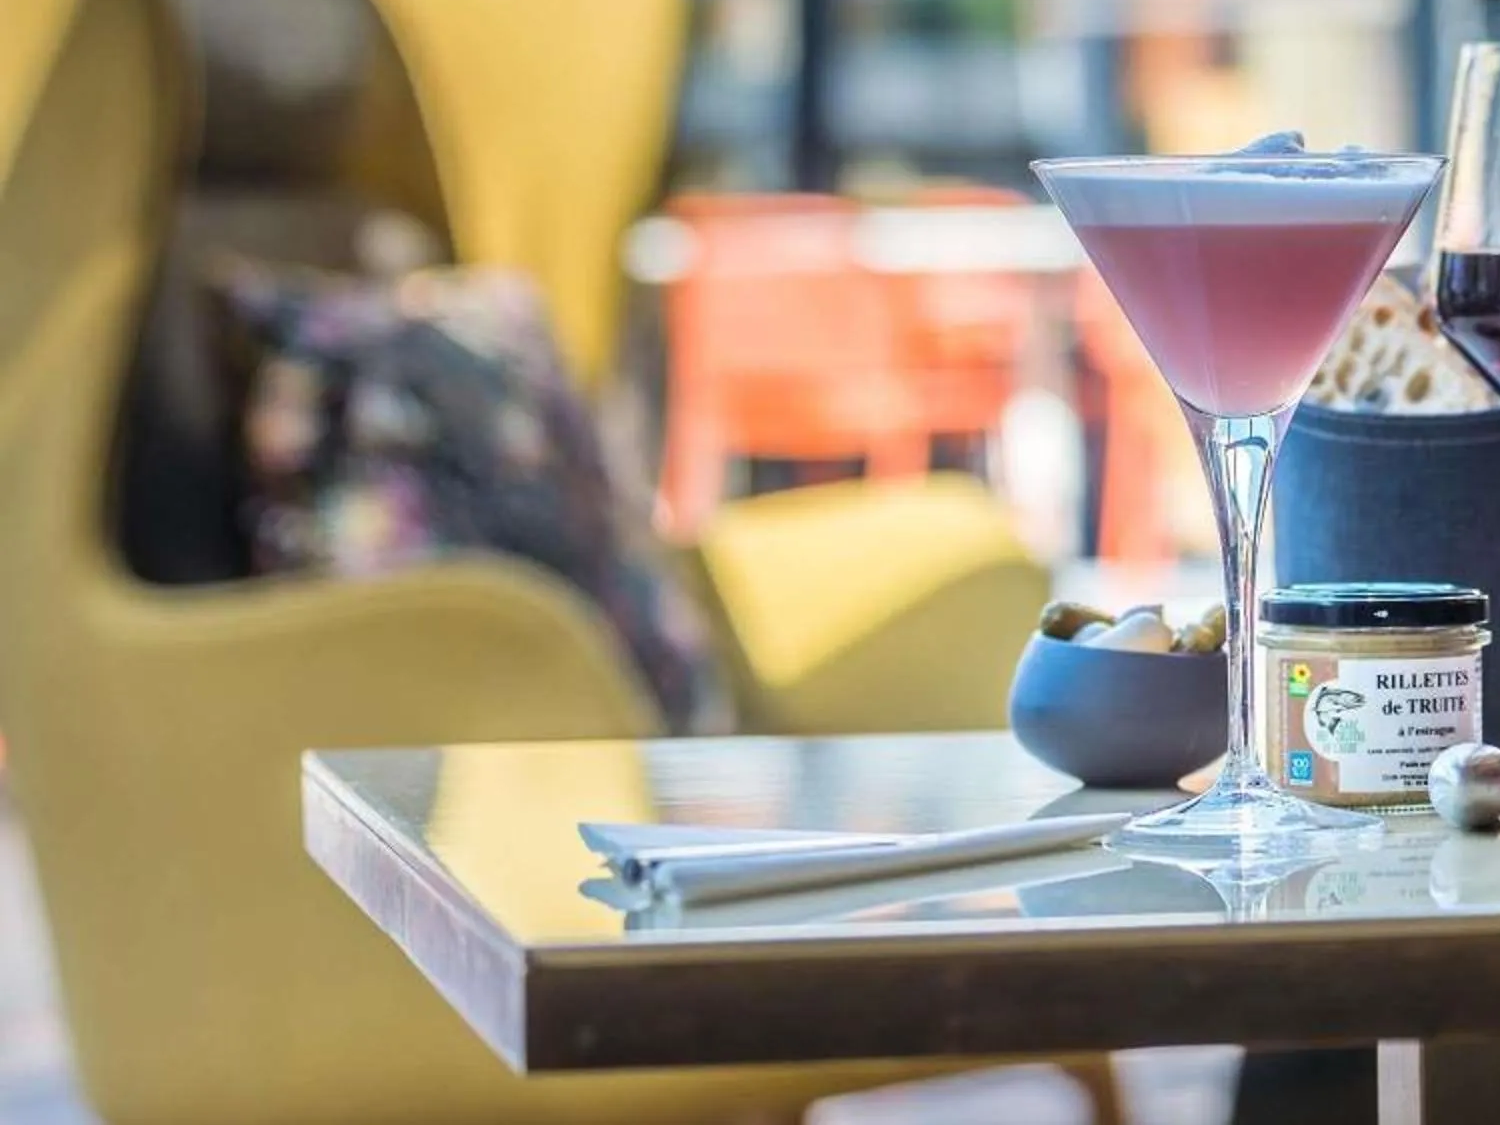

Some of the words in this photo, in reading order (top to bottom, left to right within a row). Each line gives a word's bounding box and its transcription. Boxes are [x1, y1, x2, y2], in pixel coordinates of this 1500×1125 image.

[1376, 670, 1469, 689] RILLETTES
[1382, 700, 1402, 715] de
[1406, 696, 1467, 714] TRUITE
